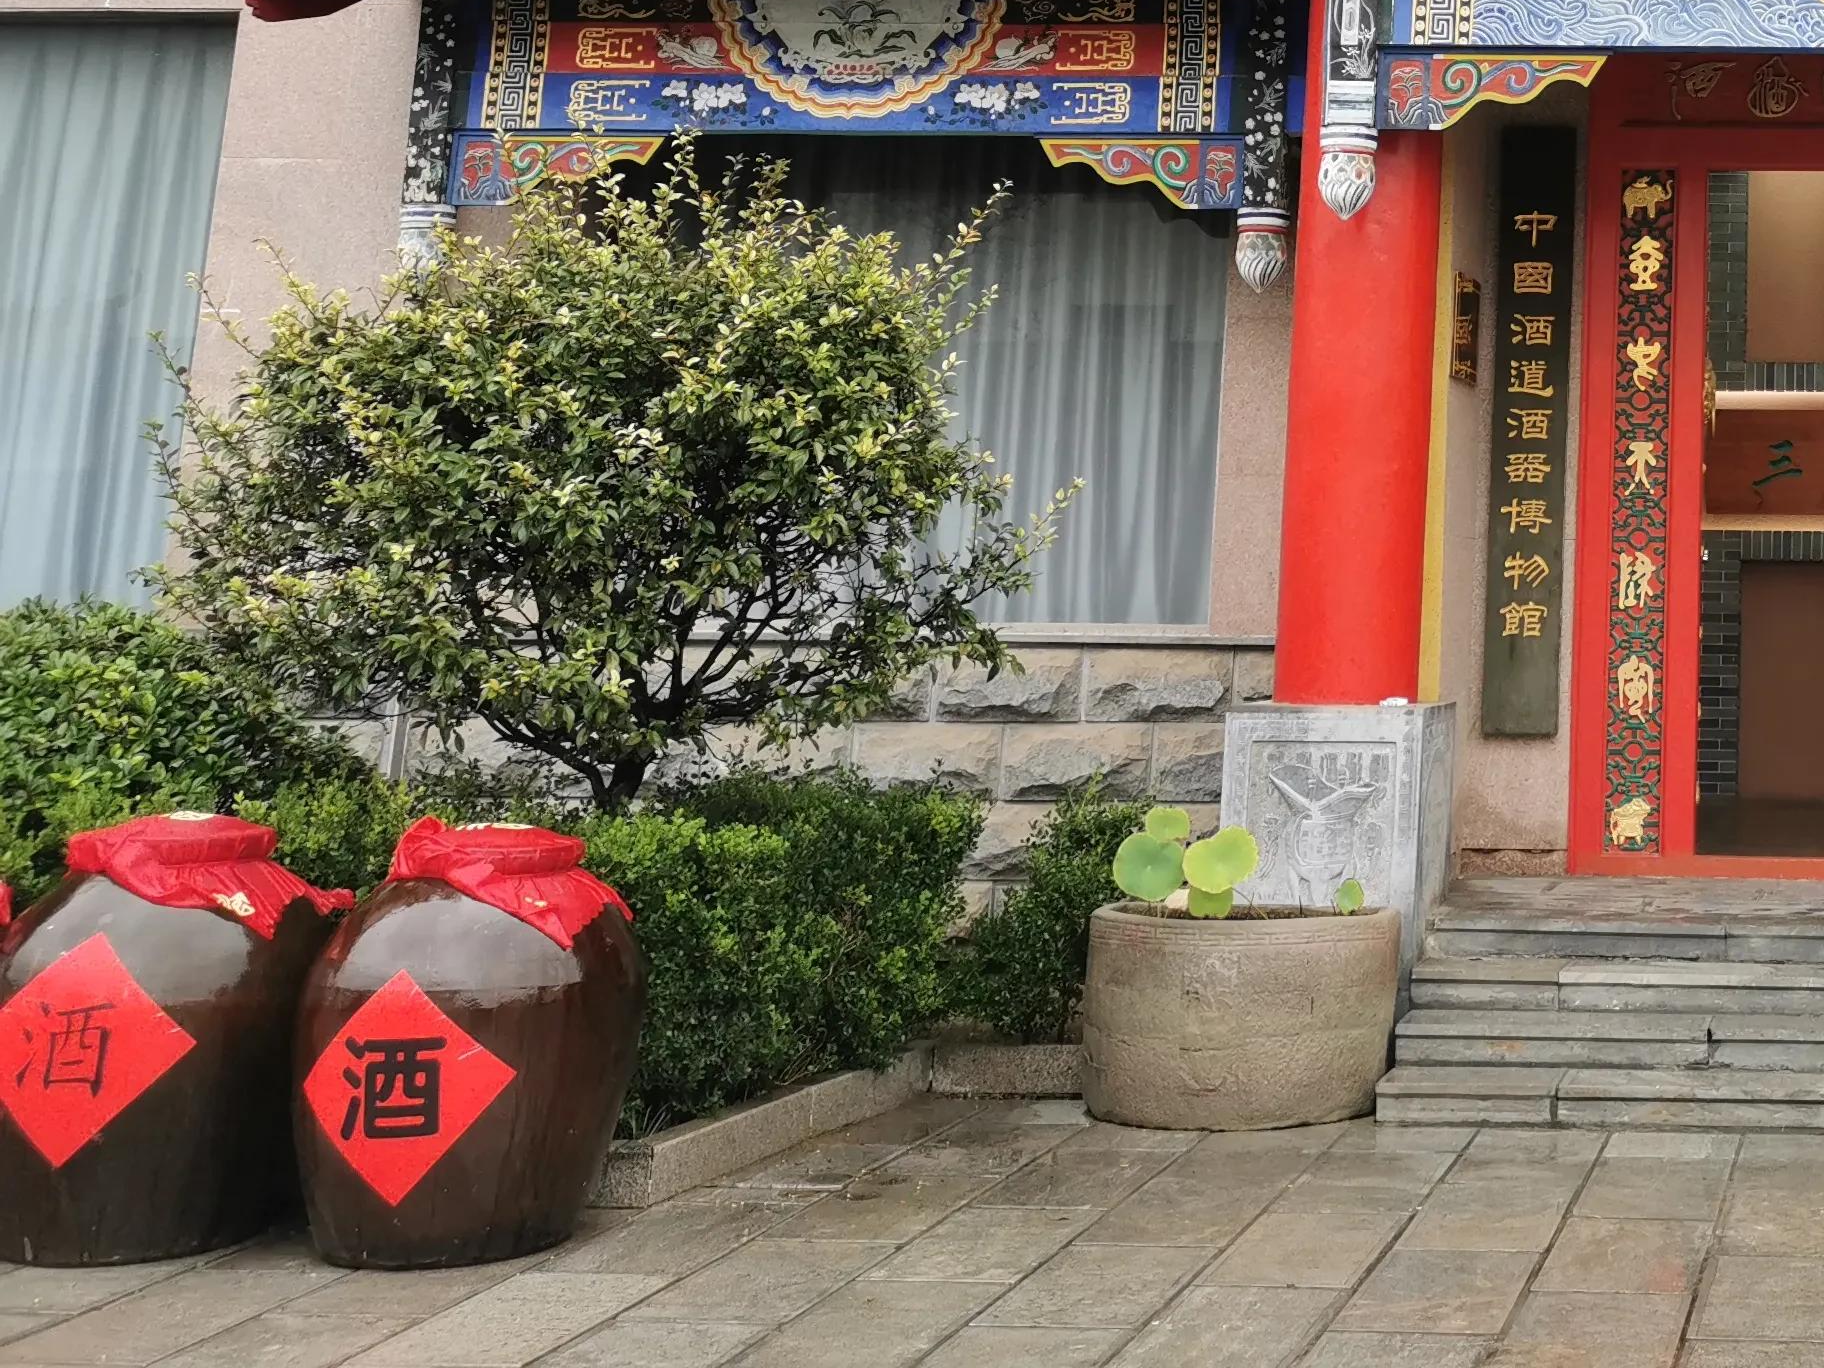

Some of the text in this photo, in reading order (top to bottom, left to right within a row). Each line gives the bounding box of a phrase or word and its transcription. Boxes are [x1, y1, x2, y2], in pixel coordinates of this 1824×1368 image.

[1499, 210, 1559, 638] 中國酒道酒器博物館
[16, 1001, 118, 1099] 酒
[340, 1035, 448, 1141] 酒
